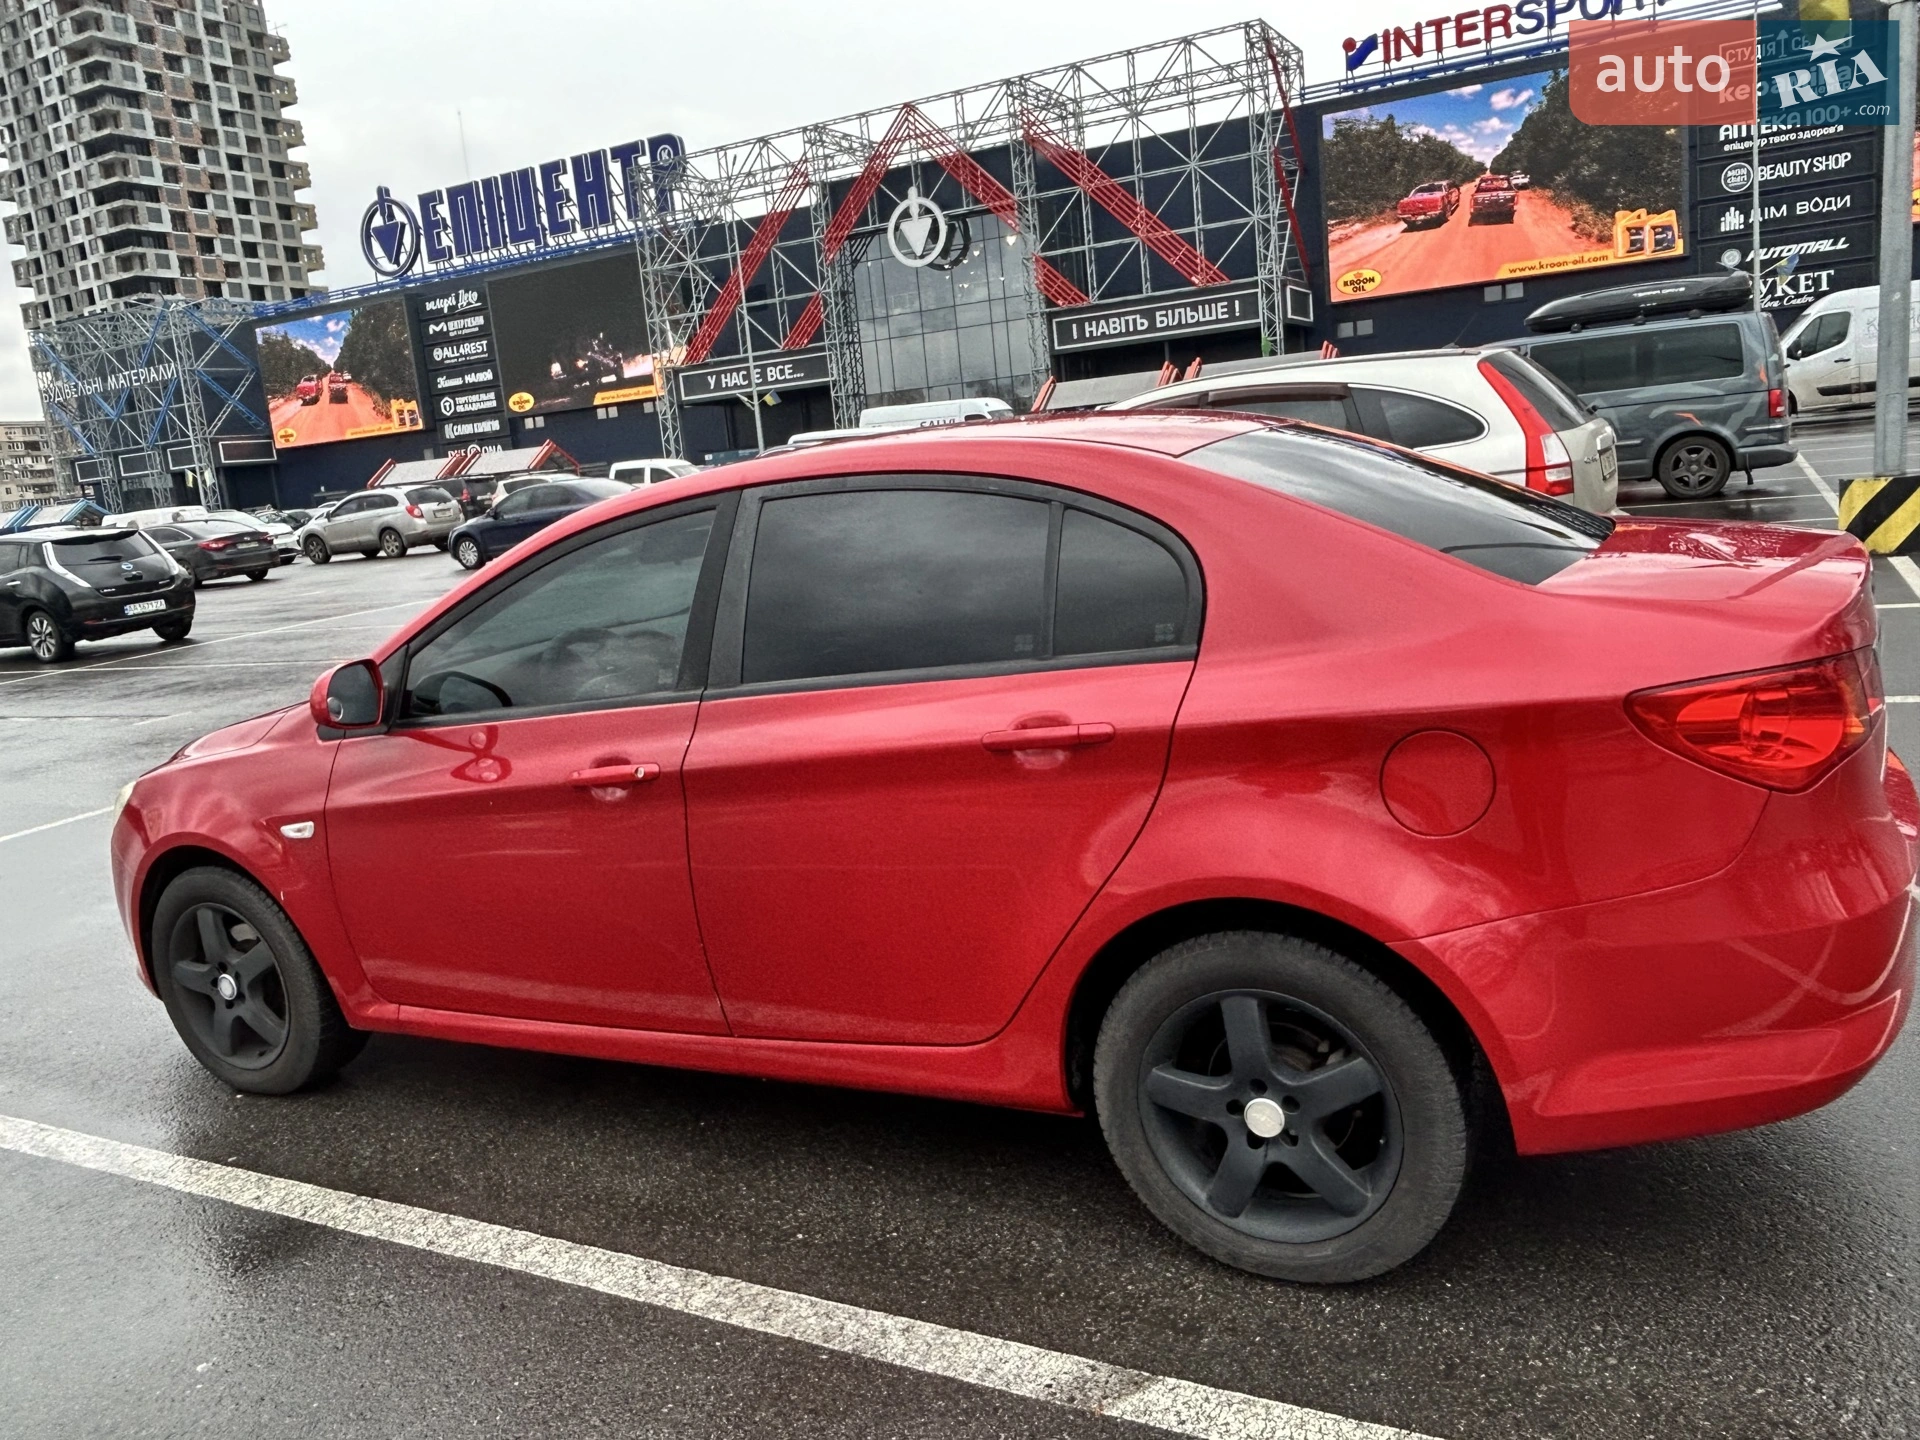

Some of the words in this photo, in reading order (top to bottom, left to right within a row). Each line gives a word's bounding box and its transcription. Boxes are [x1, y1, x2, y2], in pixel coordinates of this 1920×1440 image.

[1382, 0, 1667, 63] INTERSPO
[1806, 105, 1851, 127] 100+
[1768, 134, 1796, 144] твого
[1758, 158, 1812, 181] BEAUTY
[1813, 152, 1851, 172] SHOP
[417, 132, 686, 264] ЕПІЦЕНТР
[1796, 194, 1851, 215] ВОДИ
[1508, 253, 1609, 274] www.kroon-oil.com
[1343, 276, 1375, 287] KROON
[1352, 285, 1366, 293] OIL
[1085, 314, 1149, 338] НАВІТЬ
[1155, 302, 1229, 328] БІЛЬШЕ
[443, 340, 488, 359] ALL4REST
[42, 377, 104, 404] БУДІВЕЛЬНІ
[107, 362, 178, 391] МАТЕРІАЛИ
[707, 375, 716, 390] У
[721, 371, 749, 388] НАС
[767, 364, 805, 382] ВСЕ...
